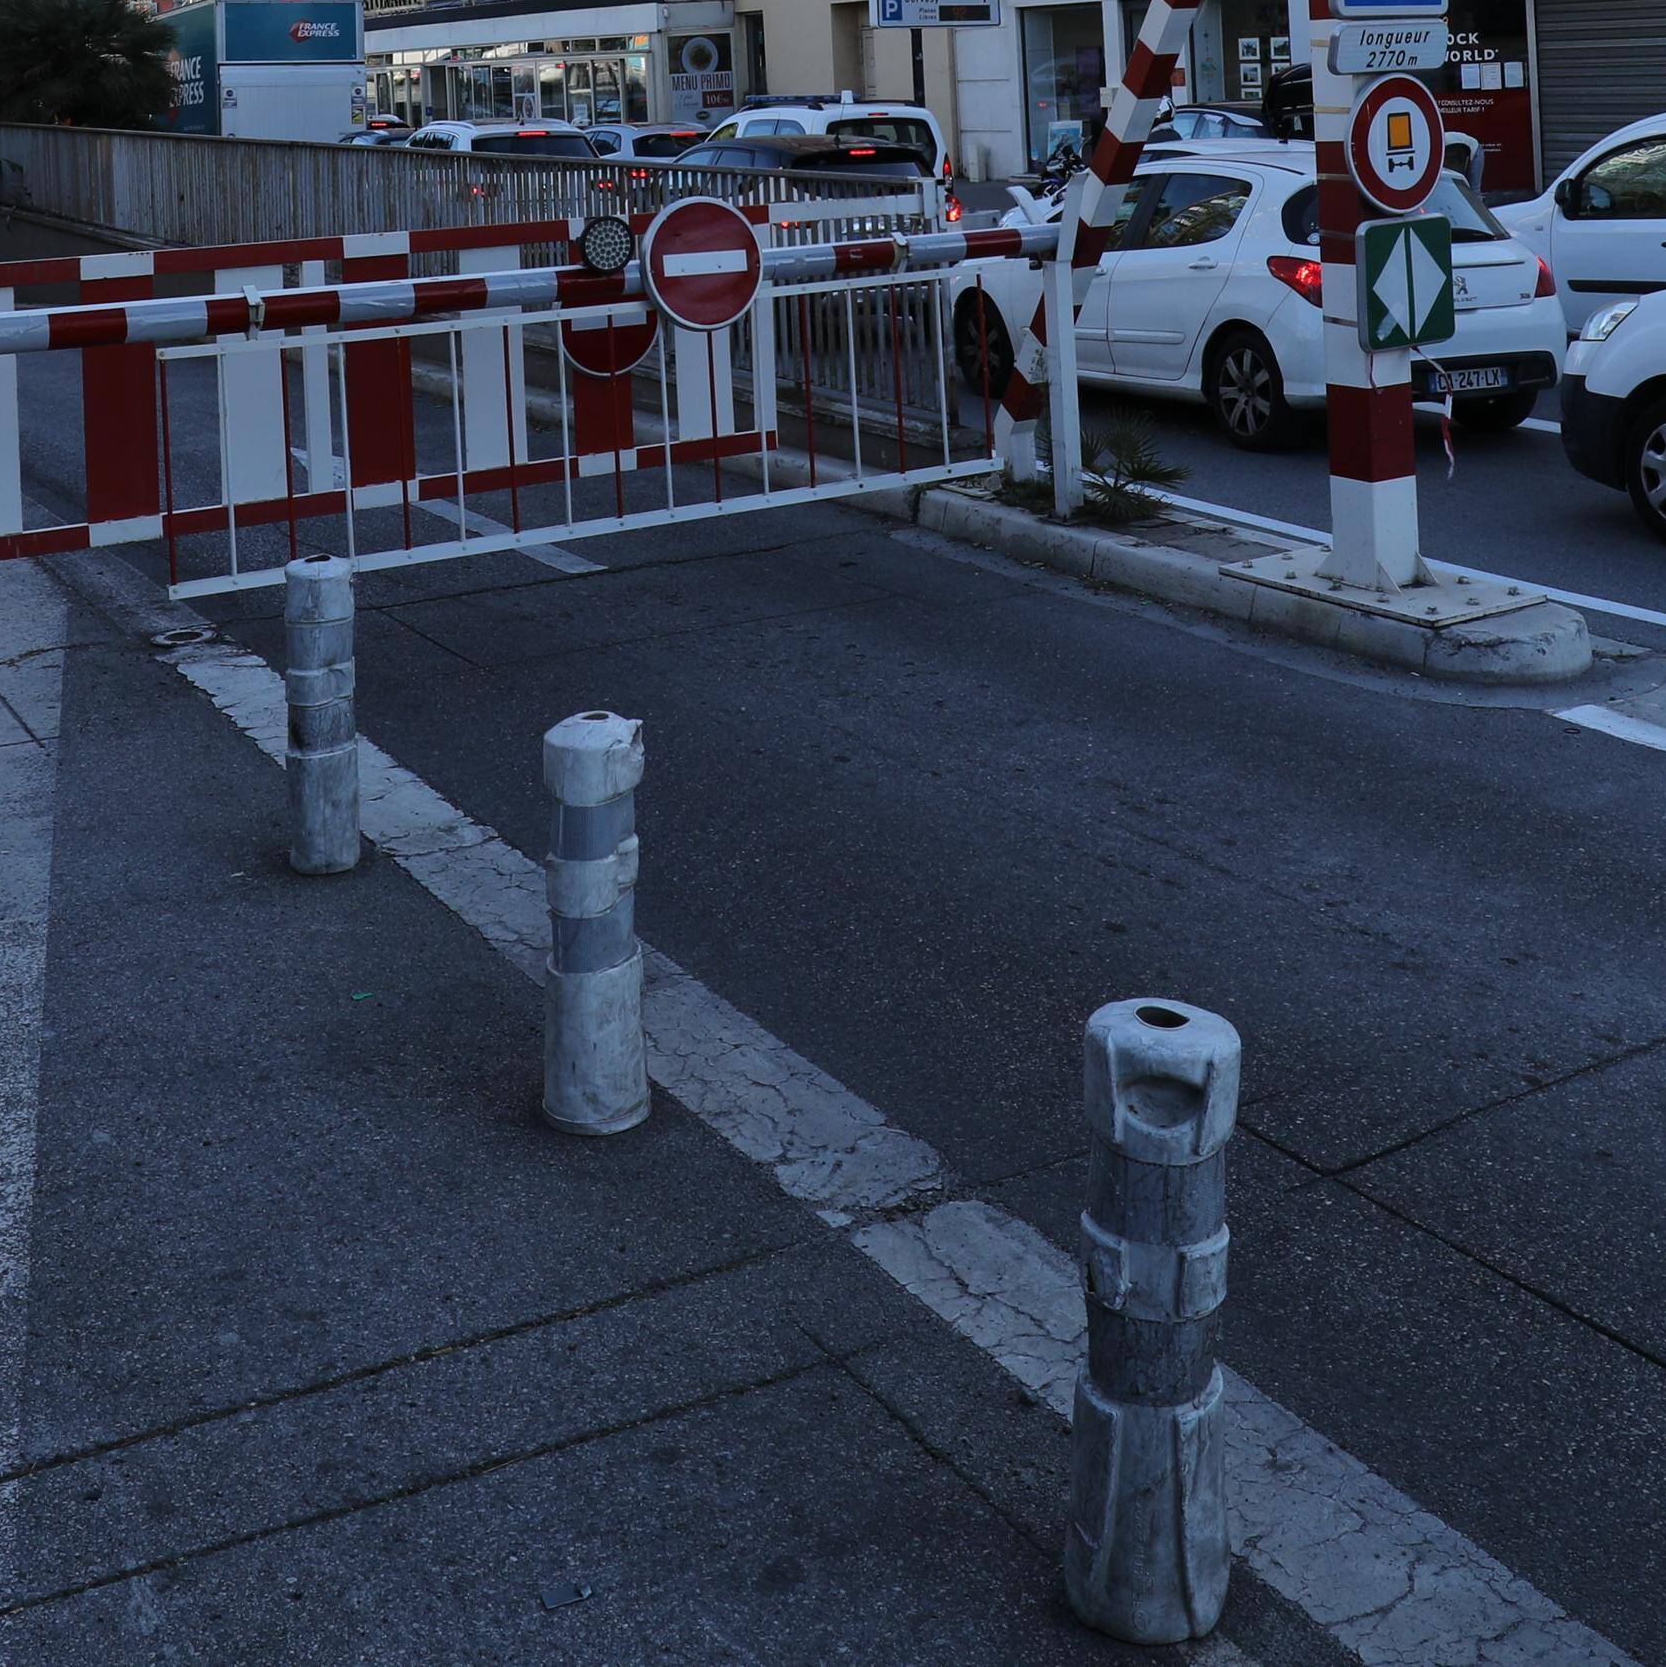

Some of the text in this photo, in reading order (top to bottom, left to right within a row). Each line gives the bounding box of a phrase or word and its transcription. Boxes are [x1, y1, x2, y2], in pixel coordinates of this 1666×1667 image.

[297, 29, 340, 38] EXPRESS
[298, 22, 337, 31] FRANCE
[1359, 29, 1431, 49] longueur
[1365, 50, 1418, 68] 2770 m
[671, 73, 731, 91] MENU PRIMO
